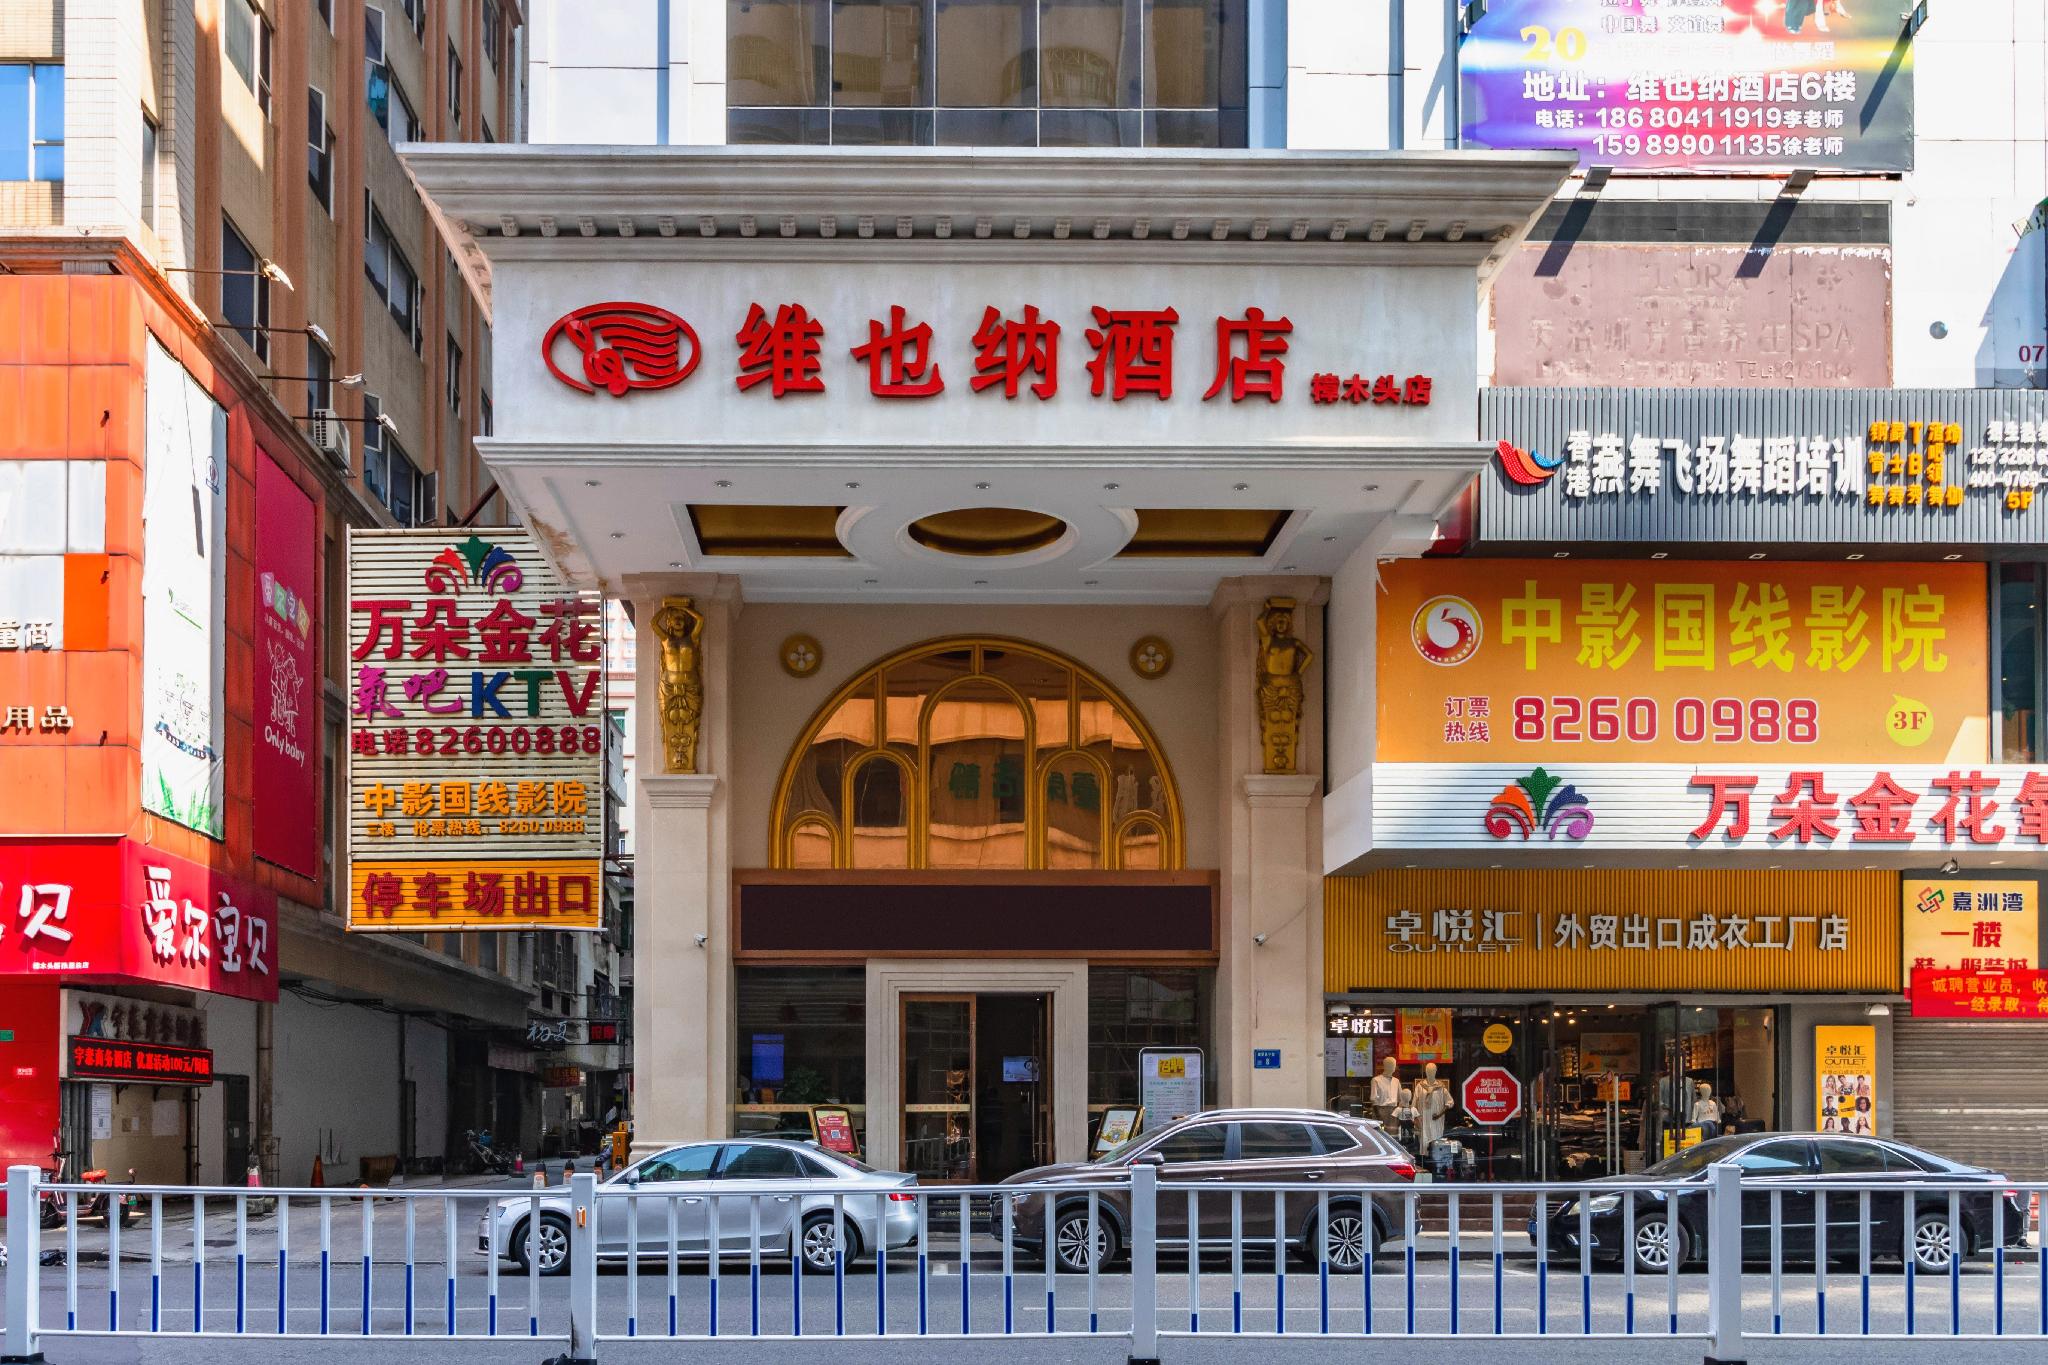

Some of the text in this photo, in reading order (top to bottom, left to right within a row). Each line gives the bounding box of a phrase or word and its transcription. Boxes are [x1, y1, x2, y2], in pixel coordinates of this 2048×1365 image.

[1520, 25, 1586, 61] 20
[1595, 107, 1643, 128] 186
[1650, 107, 1713, 128] 8041
[1592, 136, 1641, 156] 159
[1646, 135, 1714, 156] 8990
[735, 303, 1294, 403] 维也纳酒店
[2019, 346, 2045, 362] 07
[1311, 373, 1432, 405] 樟木头店
[1566, 430, 1592, 497] 香港
[1593, 433, 1864, 497] 燕舞飞扬舞蹈培训
[2008, 491, 2033, 509] 5F
[351, 598, 601, 662] 万朵金花
[1501, 579, 1948, 673] 中影国线影院
[2, 706, 74, 729] 用品
[1445, 696, 1490, 718] 订票
[1513, 695, 1820, 745] 8260 0988
[1445, 721, 1490, 743] 热线
[1893, 710, 1928, 732] 3F
[364, 780, 588, 817] 中影国线影院
[367, 822, 395, 836] 三楼
[500, 820, 539, 833] 8260
[543, 819, 585, 833] 0988
[361, 871, 592, 918] 停车场出口
[1953, 891, 2023, 911] 嘉洲湾
[0, 882, 73, 941] 贝
[141, 866, 269, 976] 爱尔宝贝
[1384, 909, 1524, 943] 卓悦汇
[1554, 913, 1850, 951] 外贸出口成衣工厂店
[1941, 921, 2002, 948] 一楼
[1388, 943, 1517, 953] OUTLET
[1330, 1019, 1393, 1034] 卓悦汇
[1824, 1058, 1866, 1066] OUTLET
[1826, 1045, 1865, 1056] 卓悦汇
